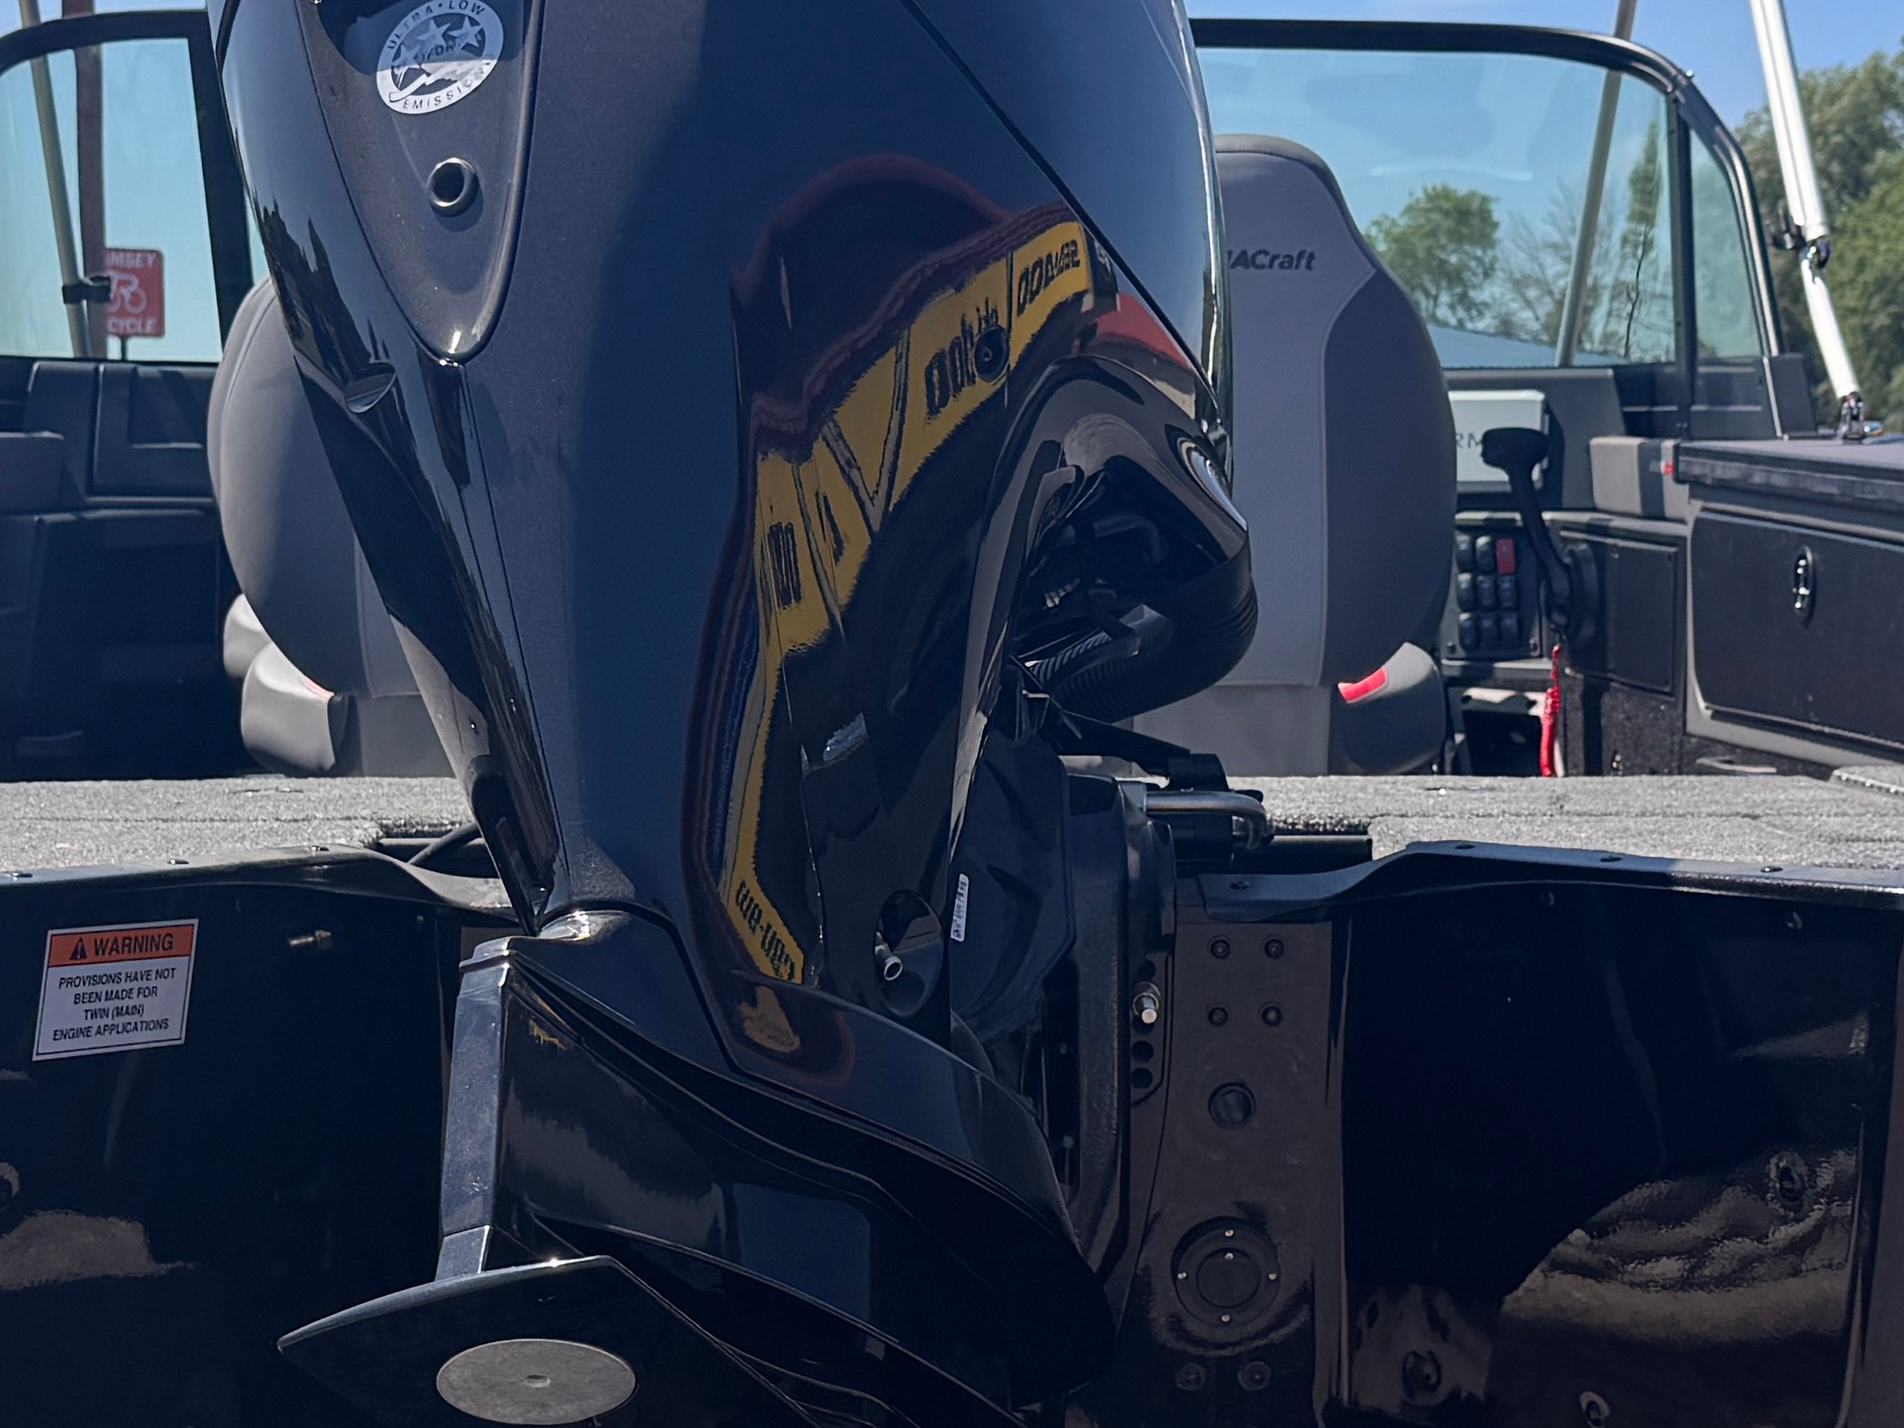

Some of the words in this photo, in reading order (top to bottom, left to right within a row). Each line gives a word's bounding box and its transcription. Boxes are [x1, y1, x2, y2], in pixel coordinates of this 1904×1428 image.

[448, 0, 486, 16] LOW
[93, 932, 175, 957] WARNING
[58, 971, 123, 989] PROVISIONS
[124, 969, 153, 984] HAVE
[154, 967, 177, 980] NOT
[73, 990, 102, 1005] BEEN
[104, 987, 135, 1002] MADE
[136, 985, 159, 999] FOR
[83, 1006, 110, 1021] TWIN
[111, 1003, 145, 1021] (MAIN)
[52, 1025, 93, 1042] ENGINE
[94, 1018, 170, 1037] APPLICATIONS
